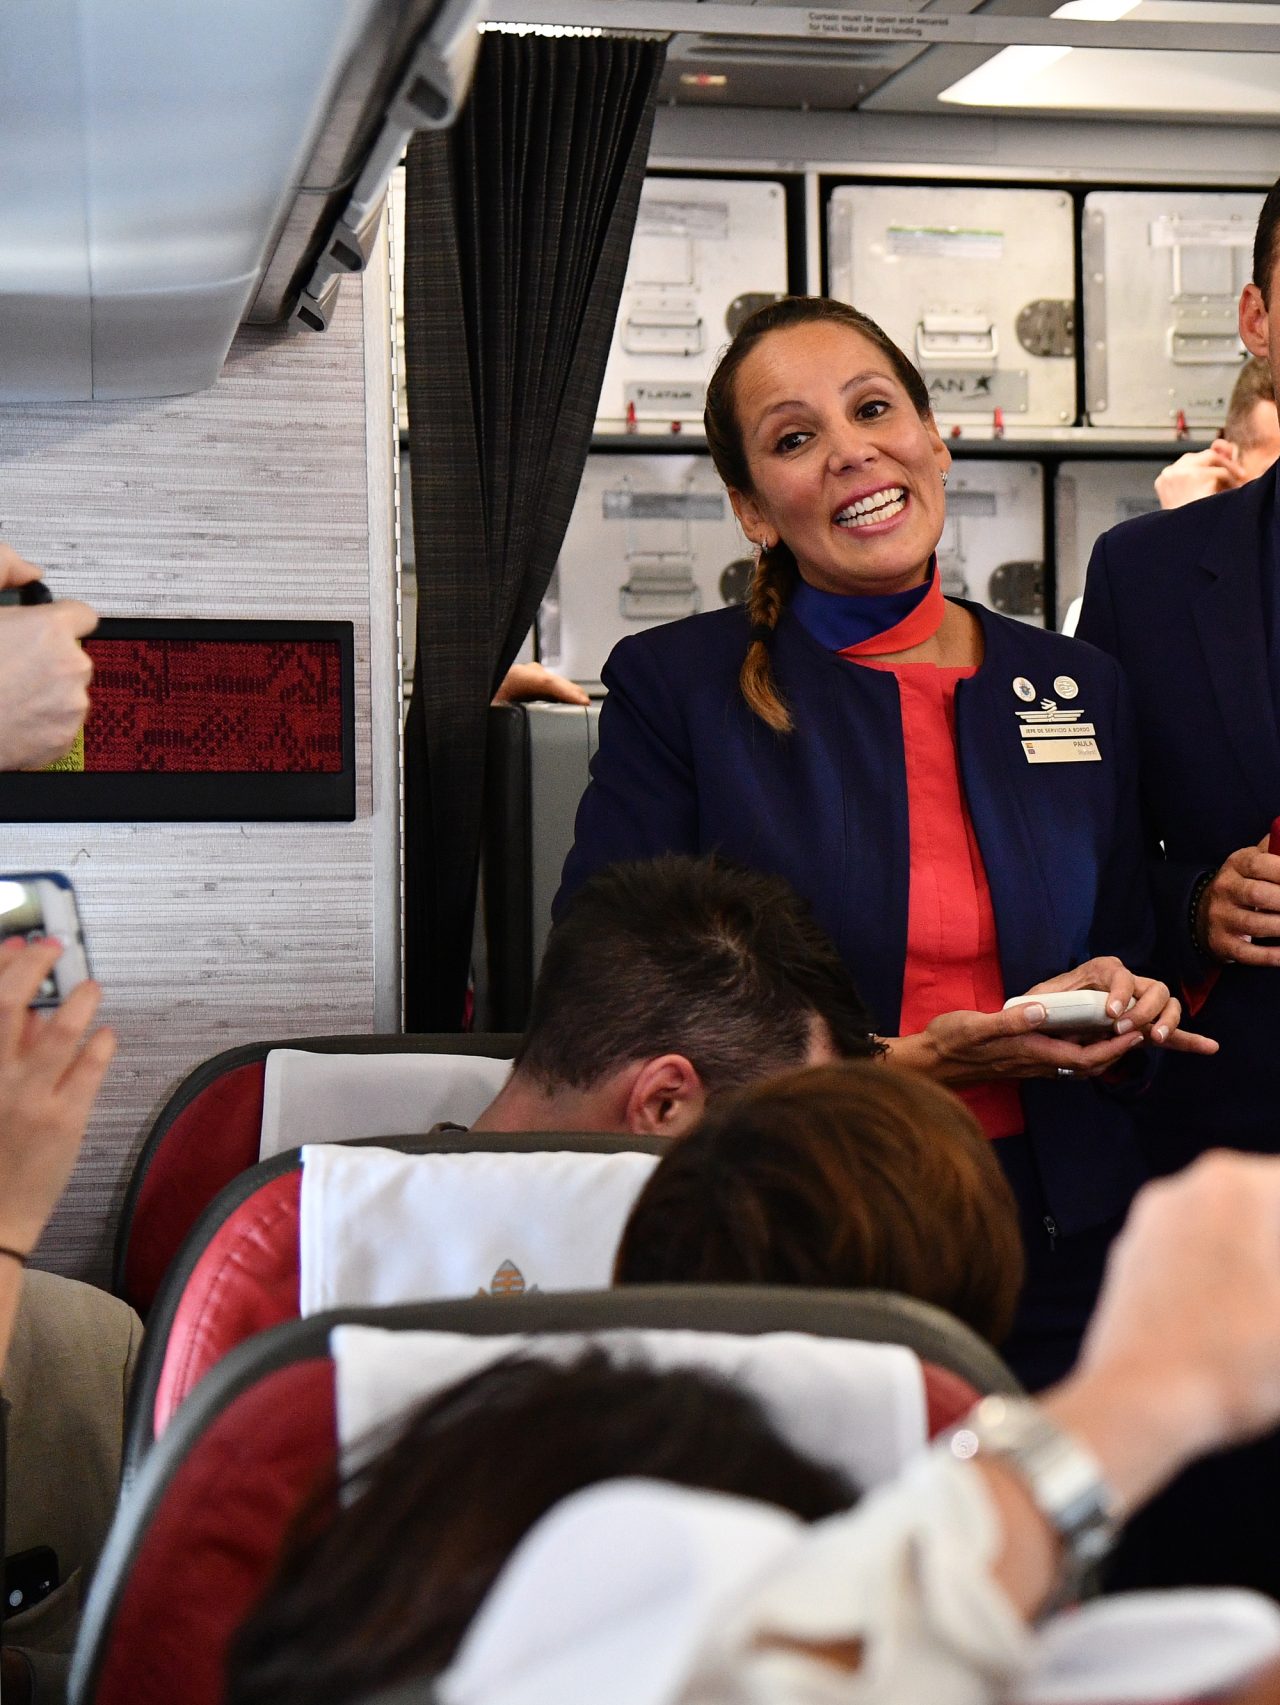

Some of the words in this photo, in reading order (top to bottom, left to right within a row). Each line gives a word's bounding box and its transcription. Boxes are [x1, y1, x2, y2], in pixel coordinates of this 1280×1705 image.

[808, 12, 839, 21] Curtain
[916, 18, 949, 26] secured
[809, 22, 820, 30] for
[841, 24, 859, 32] take
[861, 25, 873, 33] off
[892, 27, 922, 36] landing
[930, 377, 965, 392] AN
